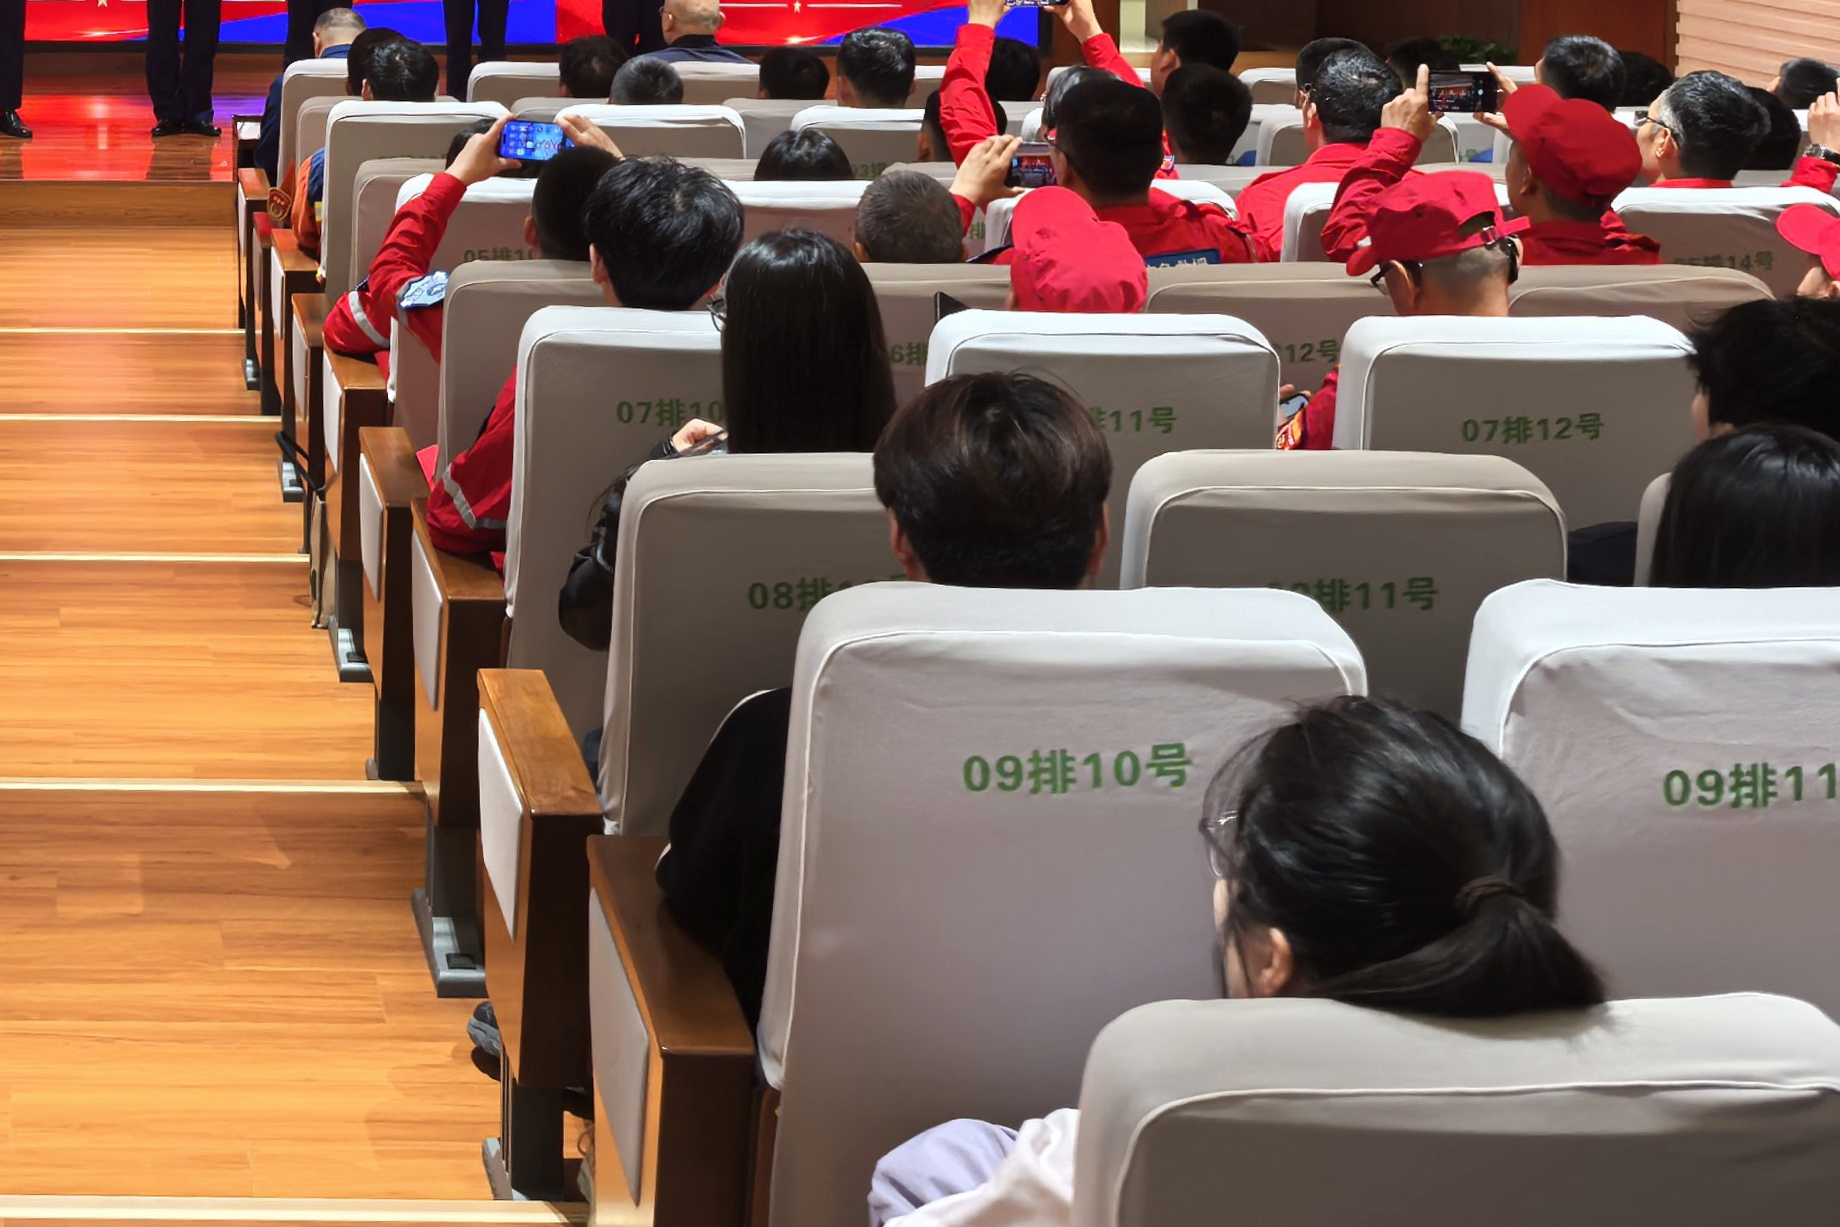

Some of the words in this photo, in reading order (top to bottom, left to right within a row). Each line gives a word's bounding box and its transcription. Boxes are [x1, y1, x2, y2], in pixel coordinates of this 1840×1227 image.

[1273, 340, 1340, 363] 12号
[1463, 412, 1604, 444] 07排12号
[963, 743, 1194, 795] 09排10号
[1663, 762, 1837, 809] 09排11
